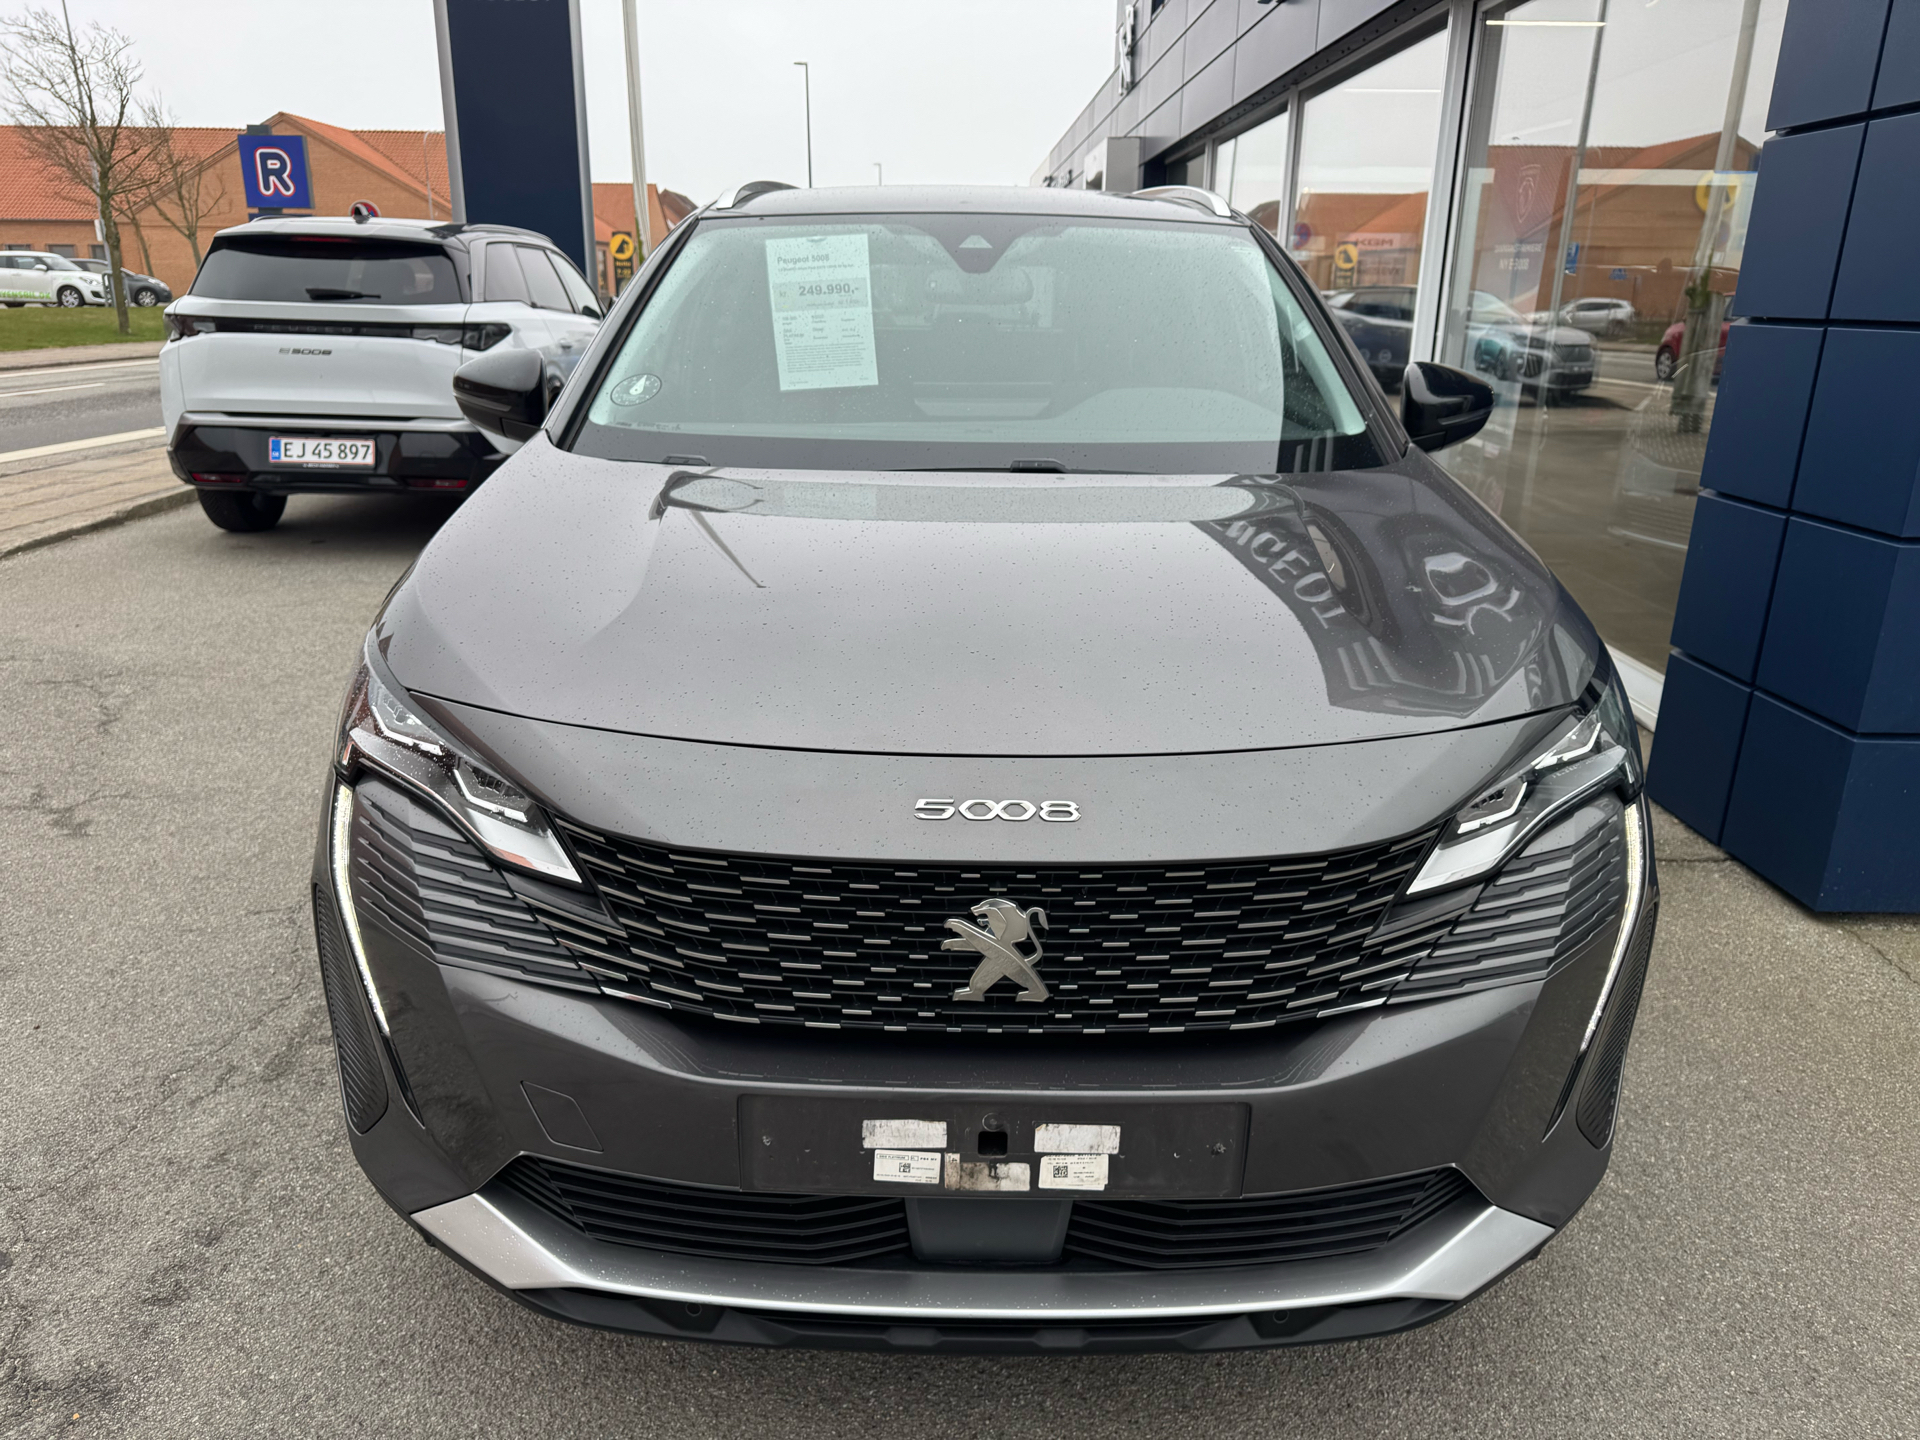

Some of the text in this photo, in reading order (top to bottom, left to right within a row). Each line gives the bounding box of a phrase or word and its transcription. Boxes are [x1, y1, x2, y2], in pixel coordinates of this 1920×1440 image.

[254, 146, 296, 197] R
[777, 253, 830, 265] Peugeot 5008
[798, 283, 860, 296] 249.990,-
[283, 442, 306, 458] EJ
[312, 442, 333, 459] 45
[338, 443, 371, 460] 897
[913, 798, 1082, 822] 5008
